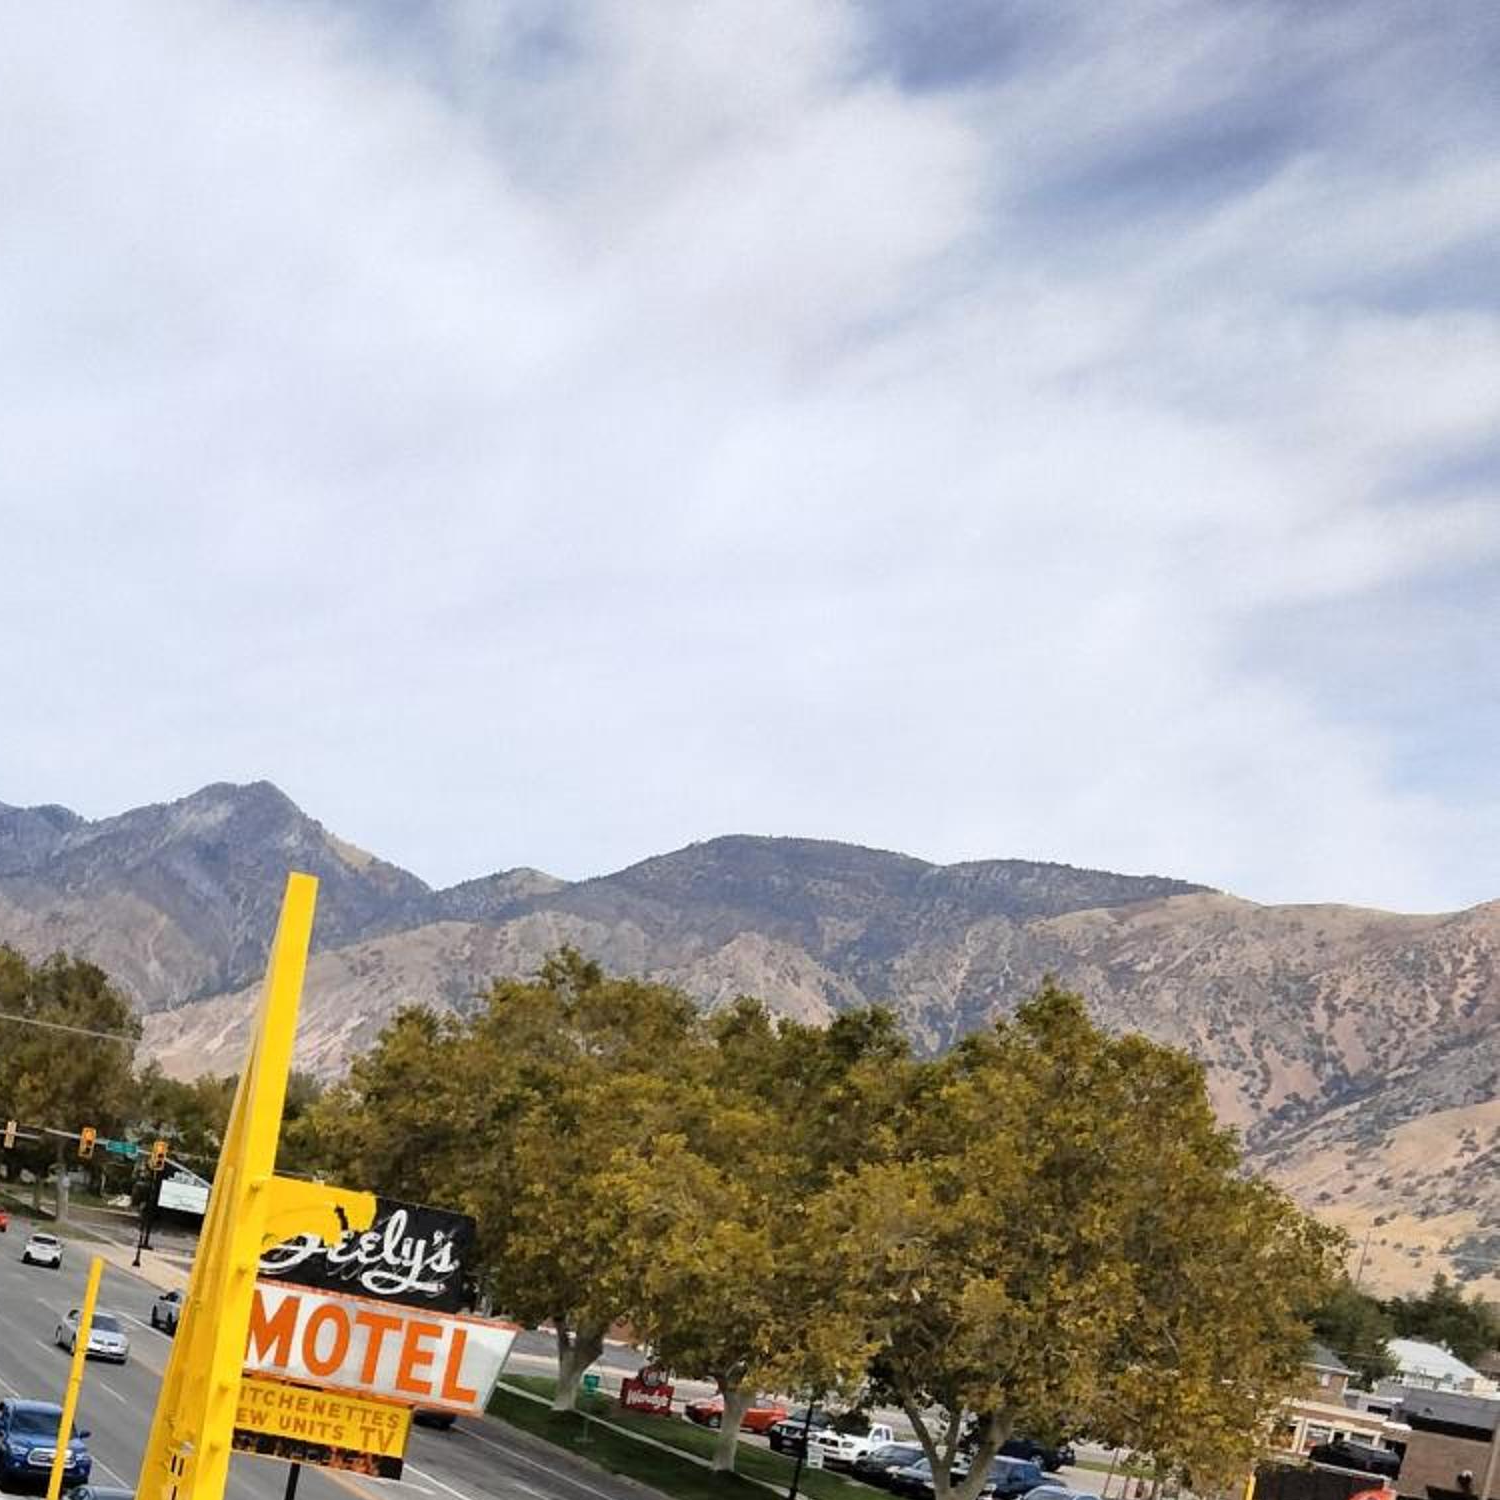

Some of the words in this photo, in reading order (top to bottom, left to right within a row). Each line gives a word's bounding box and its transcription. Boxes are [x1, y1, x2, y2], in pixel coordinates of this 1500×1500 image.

[242, 1288, 478, 1404] MOTEL
[234, 1407, 269, 1426] EW
[278, 1415, 346, 1441] UNITS
[358, 1425, 397, 1453] TV
[238, 1384, 402, 1430] ITCHENETTES
